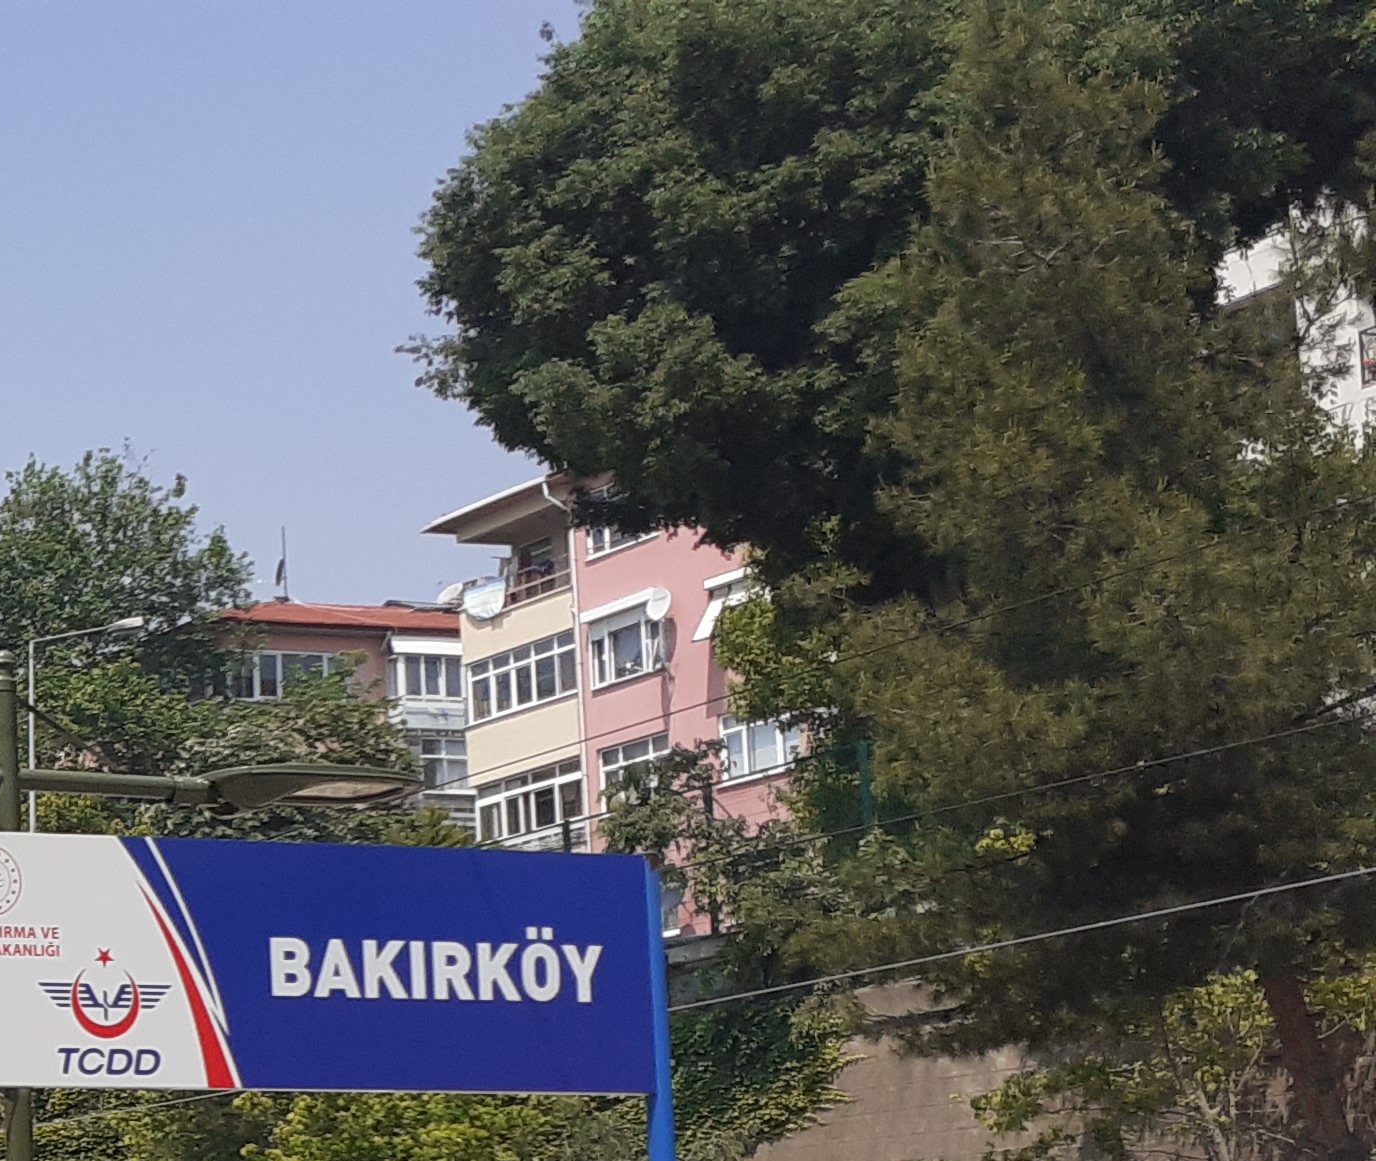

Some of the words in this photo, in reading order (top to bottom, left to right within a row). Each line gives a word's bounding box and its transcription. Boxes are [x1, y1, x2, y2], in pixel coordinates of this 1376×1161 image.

[41, 926, 60, 939] VE
[269, 926, 604, 1003] BAKIRKÖY
[56, 1047, 161, 1076] TCDD
